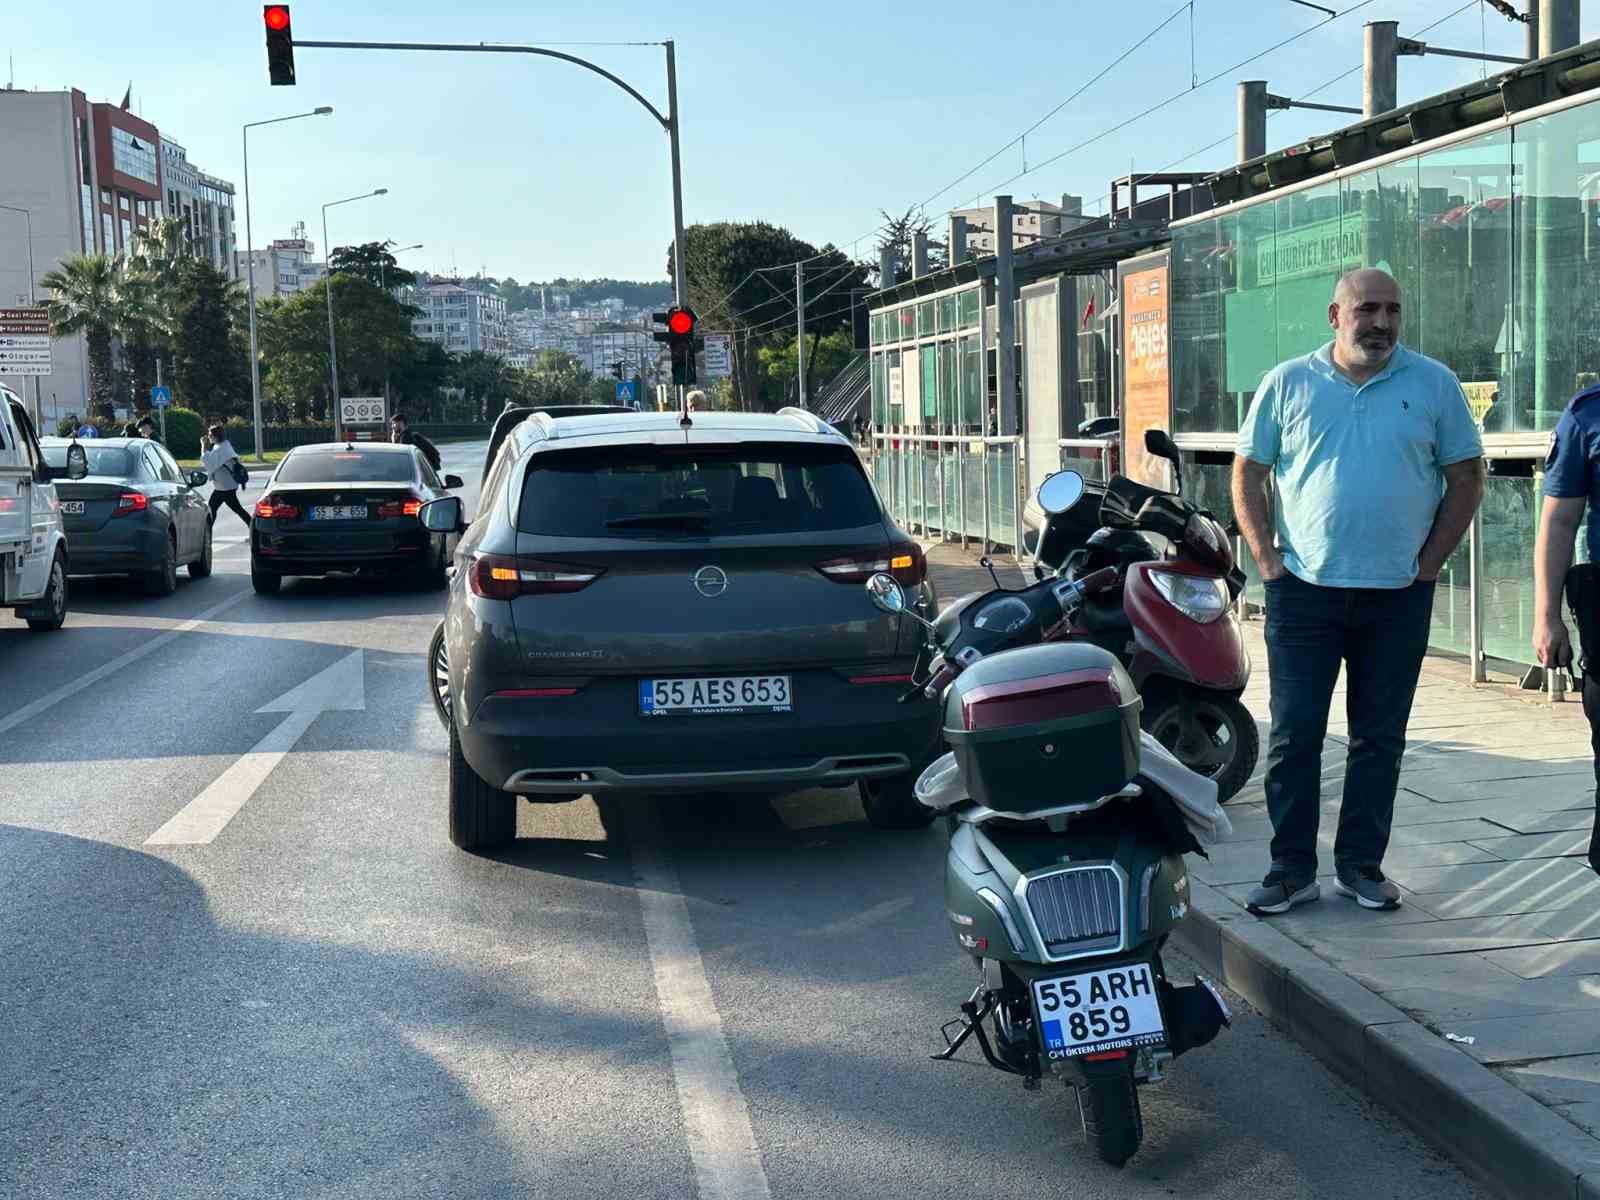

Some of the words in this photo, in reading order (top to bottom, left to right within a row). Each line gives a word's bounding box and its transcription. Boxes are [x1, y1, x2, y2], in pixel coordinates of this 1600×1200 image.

[65, 502, 84, 512] 454
[655, 681, 685, 706] 55
[692, 679, 735, 705] AES
[741, 677, 787, 703] 653
[1040, 980, 1082, 1012] 55
[1089, 968, 1151, 1004] ARH
[1049, 1038, 1062, 1049] TR
[1069, 1005, 1131, 1040] 859
[1097, 1038, 1133, 1051] MOTORS
